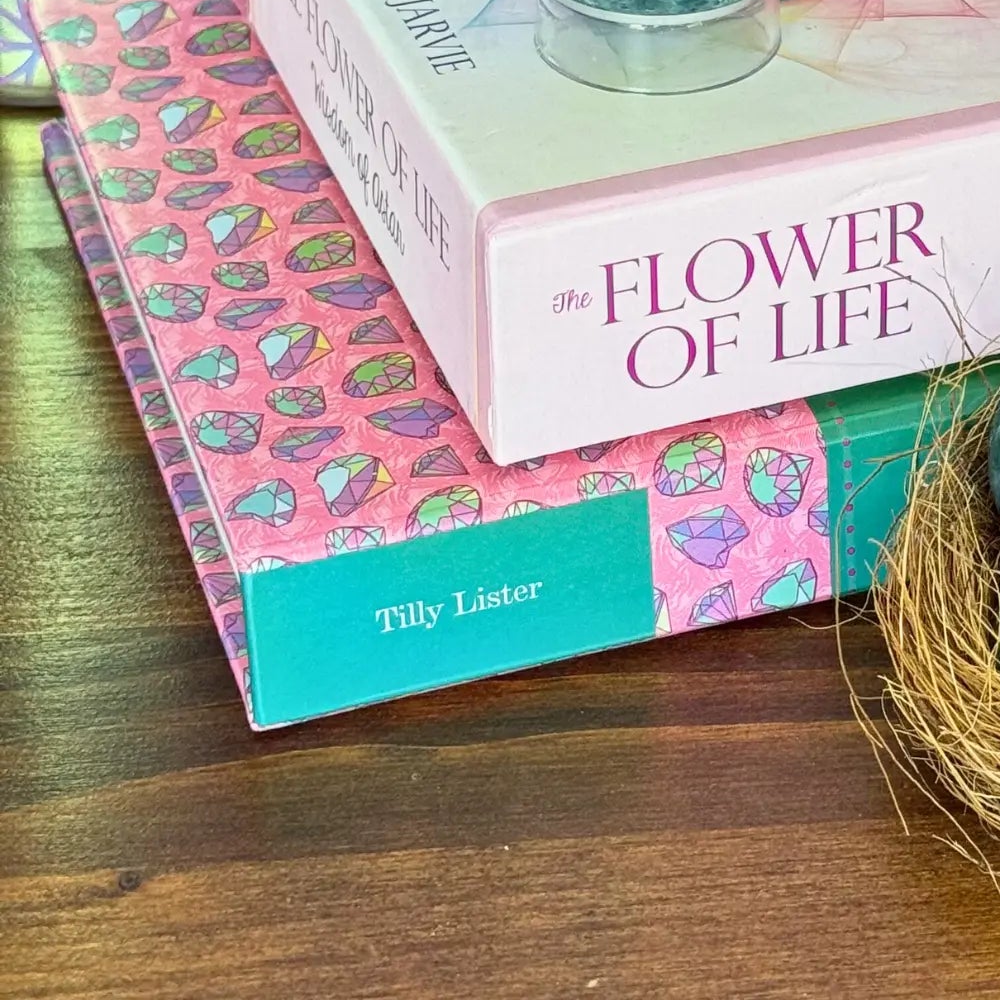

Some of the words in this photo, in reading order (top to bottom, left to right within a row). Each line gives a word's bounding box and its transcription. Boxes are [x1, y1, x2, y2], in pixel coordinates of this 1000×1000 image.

[356, 151, 370, 207] of
[381, 120, 408, 193] OF
[413, 166, 451, 273] LIFE
[552, 288, 593, 315] The
[598, 200, 937, 327] FLOWER
[626, 311, 741, 390] OF
[769, 275, 914, 364] LIFE
[375, 601, 443, 633] Tilly
[451, 579, 543, 616] Lister
